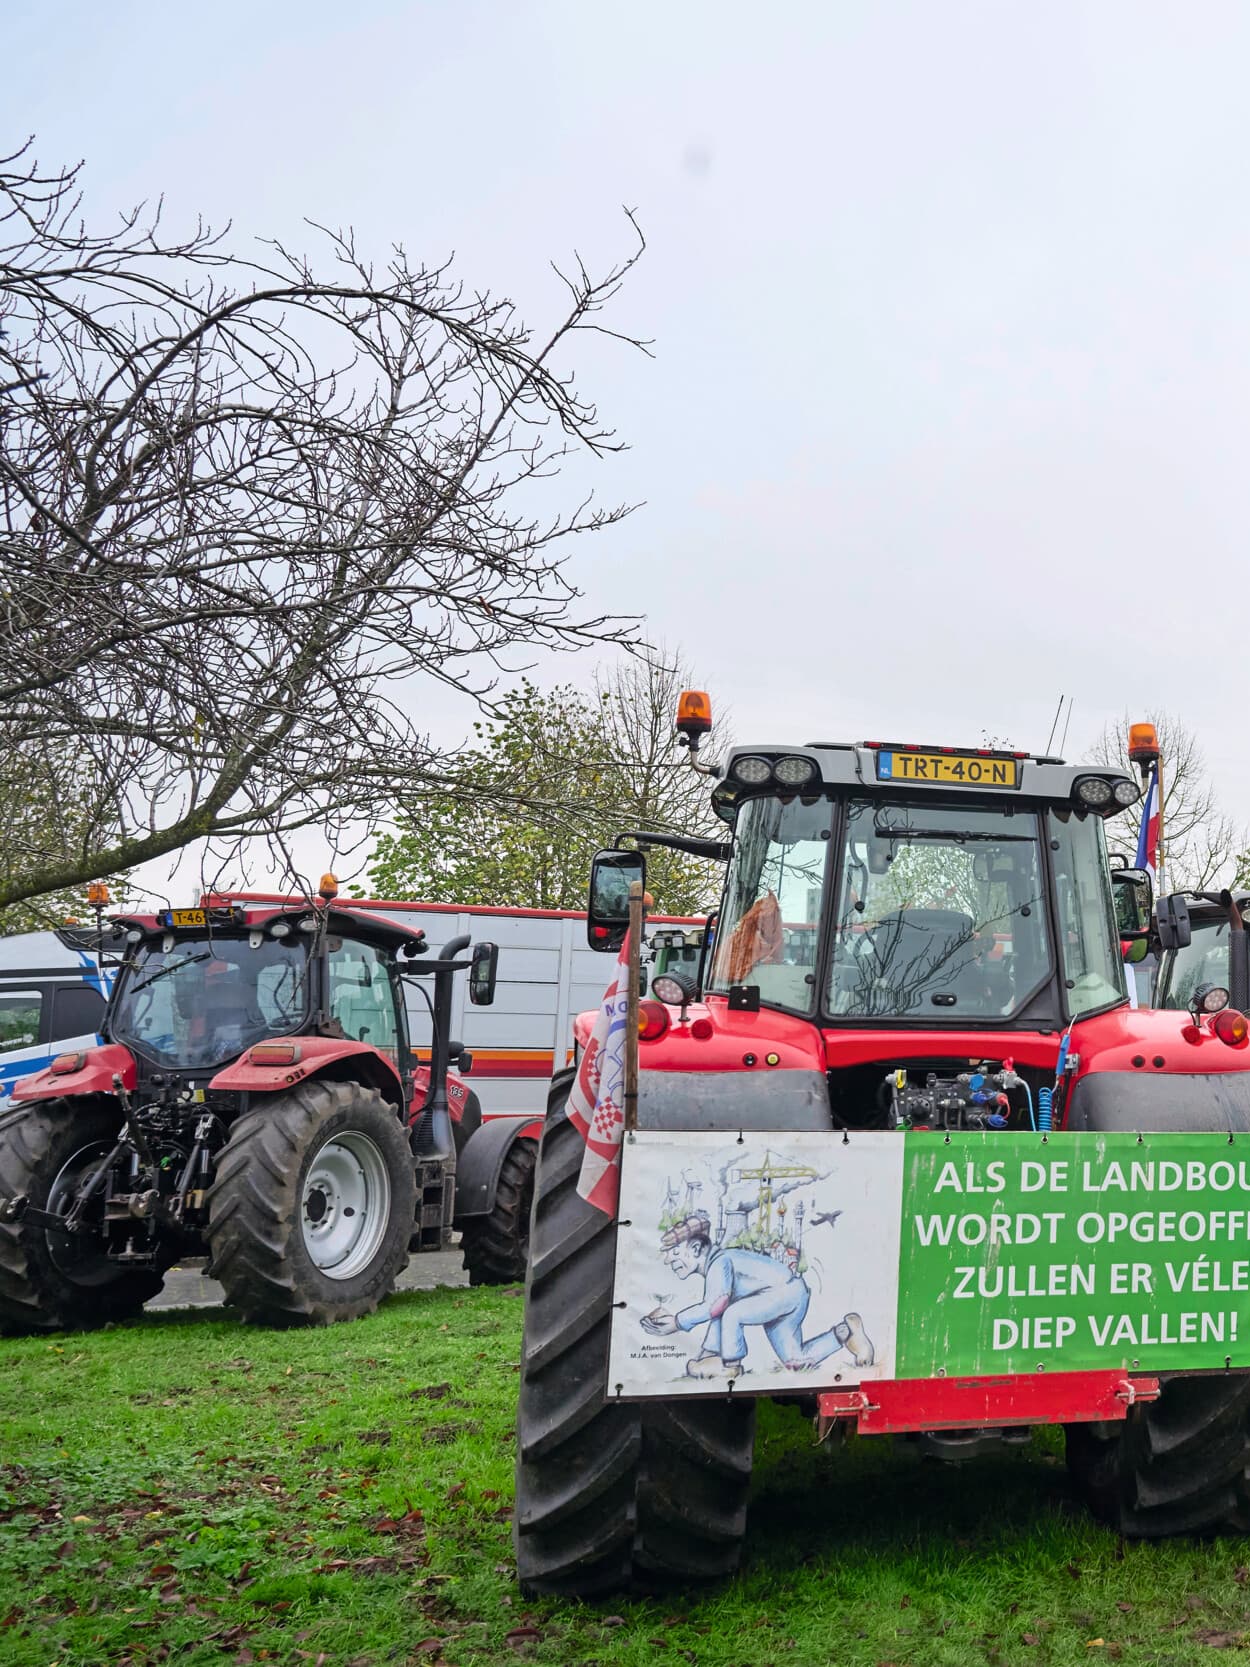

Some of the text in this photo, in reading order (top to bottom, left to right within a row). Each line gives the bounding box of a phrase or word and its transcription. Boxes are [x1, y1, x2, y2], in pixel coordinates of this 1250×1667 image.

[899, 756, 1007, 783] TRT-40-N
[934, 1161, 1006, 1193] ALS
[1020, 1161, 1068, 1192] DE
[915, 1212, 1066, 1246] WORDT
[953, 1264, 1096, 1299] ZULLEN
[1109, 1263, 1153, 1294] ER
[992, 1311, 1239, 1351] DIEP VALLEN!
[662, 1351, 687, 1359] Dongen
